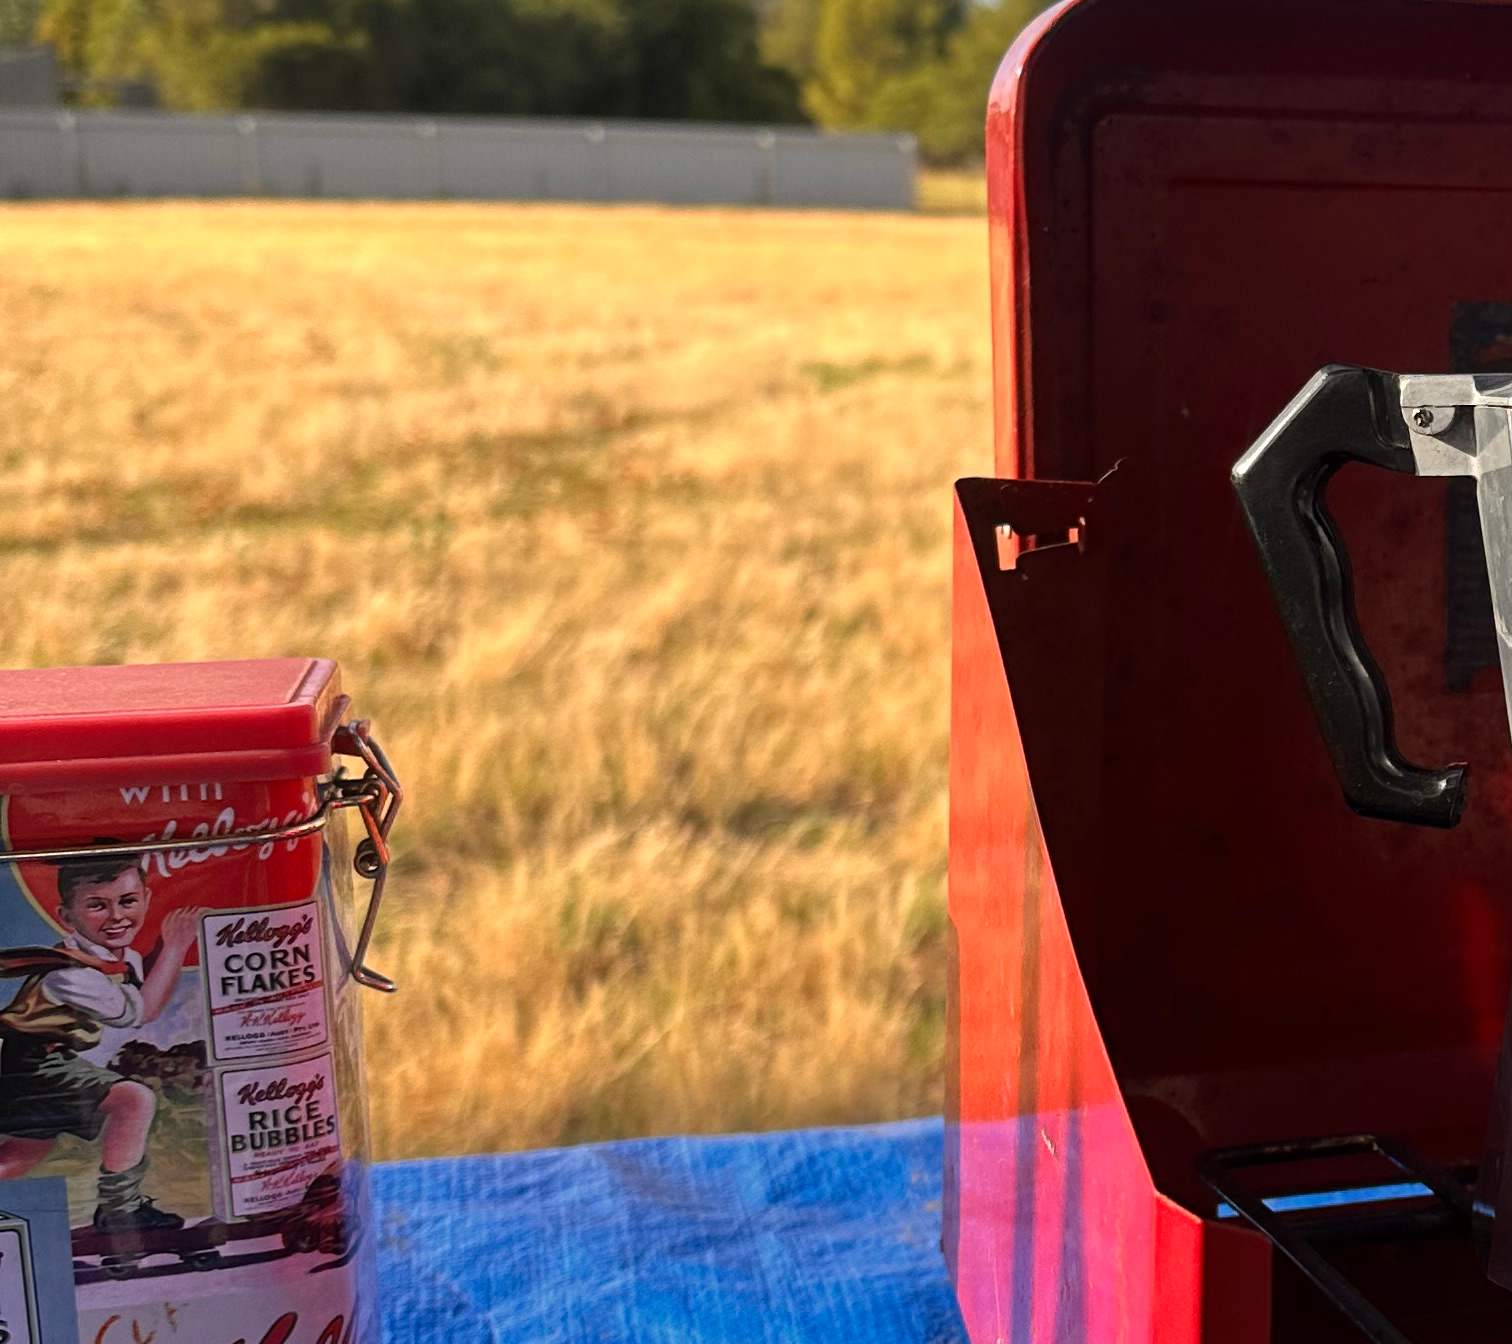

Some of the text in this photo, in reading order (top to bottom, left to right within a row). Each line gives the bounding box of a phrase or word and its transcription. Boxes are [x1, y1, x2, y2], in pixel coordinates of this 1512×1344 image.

[216, 914, 314, 948] Kellogg's
[224, 944, 311, 974] CORN
[221, 964, 316, 996] FLAKES
[237, 1073, 325, 1106] Kellogg's
[248, 1100, 322, 1131] RICE
[231, 1115, 335, 1153] BUBBLES
